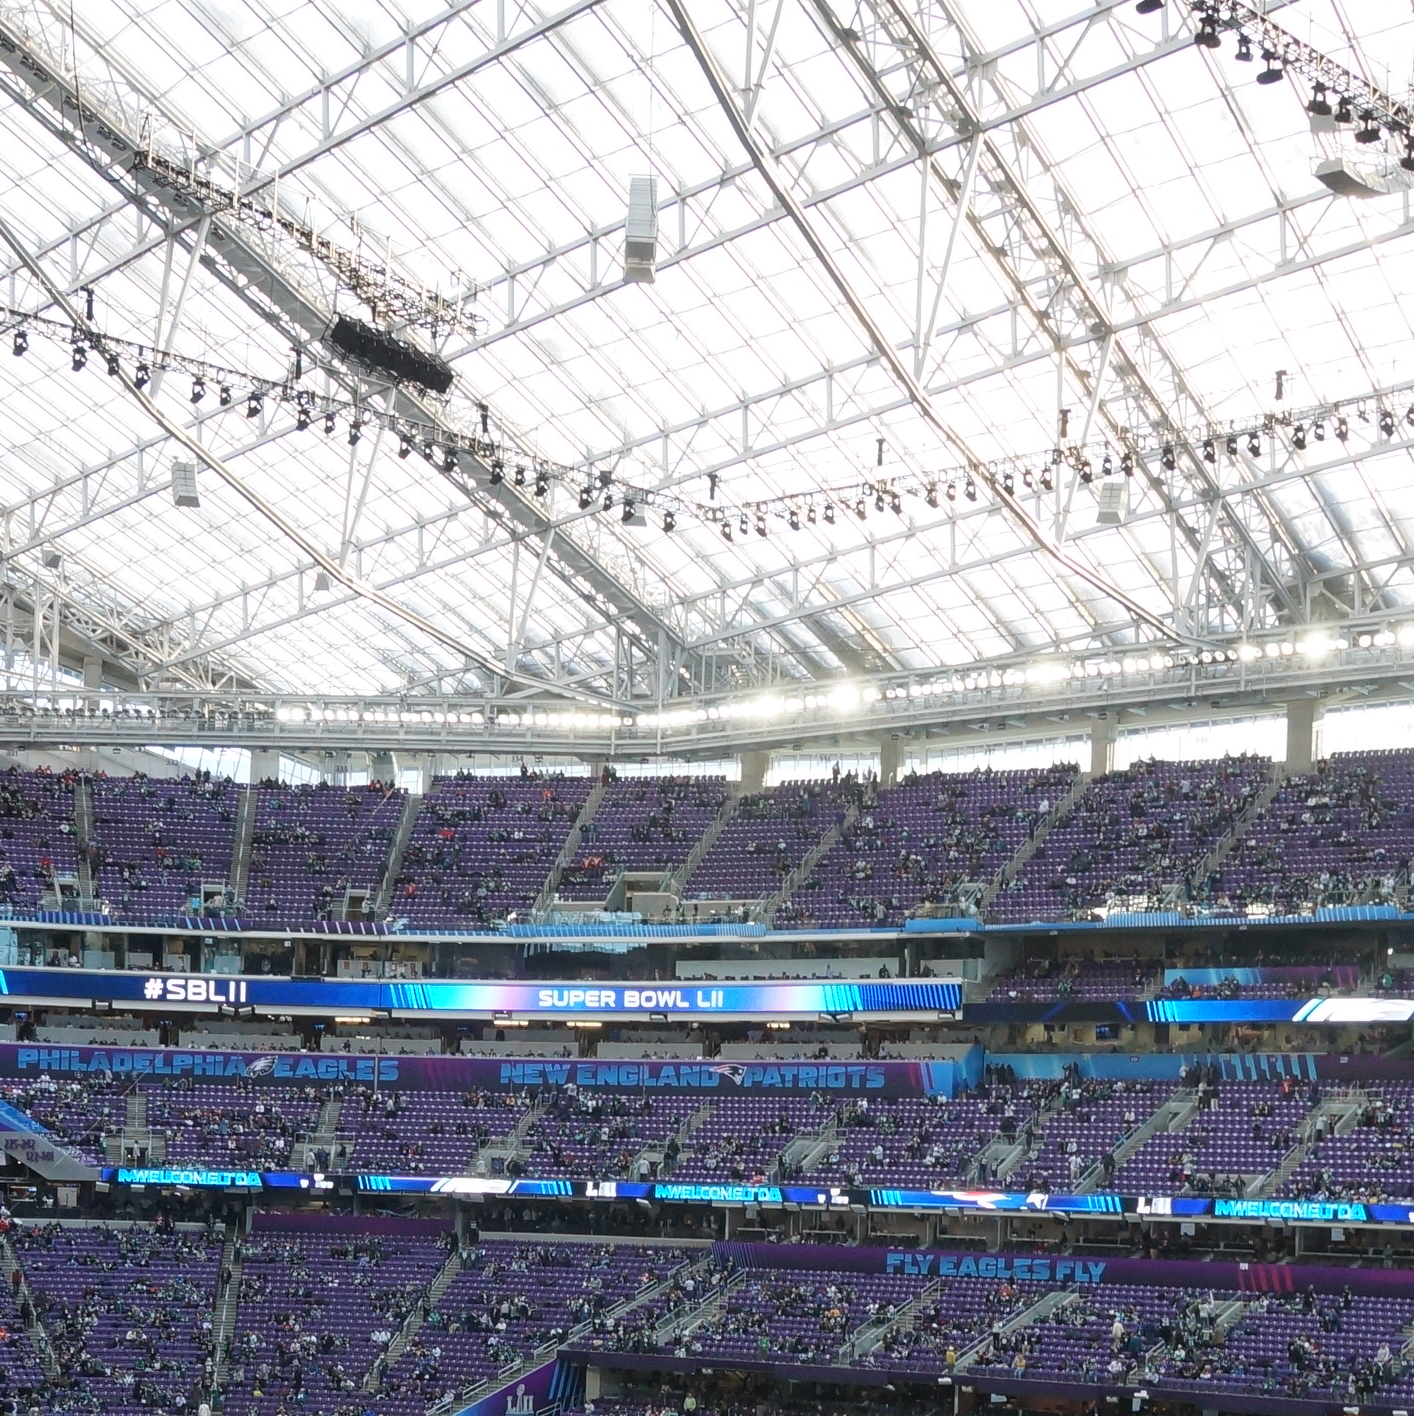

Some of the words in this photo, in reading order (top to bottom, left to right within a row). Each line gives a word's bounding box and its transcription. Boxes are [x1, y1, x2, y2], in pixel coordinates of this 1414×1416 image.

[144, 978, 246, 1003] #SBLII
[538, 989, 614, 1009] SUPER
[623, 989, 689, 1009] BOWL
[697, 989, 723, 1009] LII
[17, 1048, 247, 1076] PHILADELPHIA
[276, 1057, 399, 1081] EAGLES
[500, 1063, 572, 1086] NEW
[583, 1064, 719, 1088] ENGLAND
[743, 1065, 885, 1088] PATRIOTS
[887, 1252, 934, 1276] FLY
[940, 1254, 1050, 1281] EAGLES
[1052, 1259, 1106, 1284] FLY
